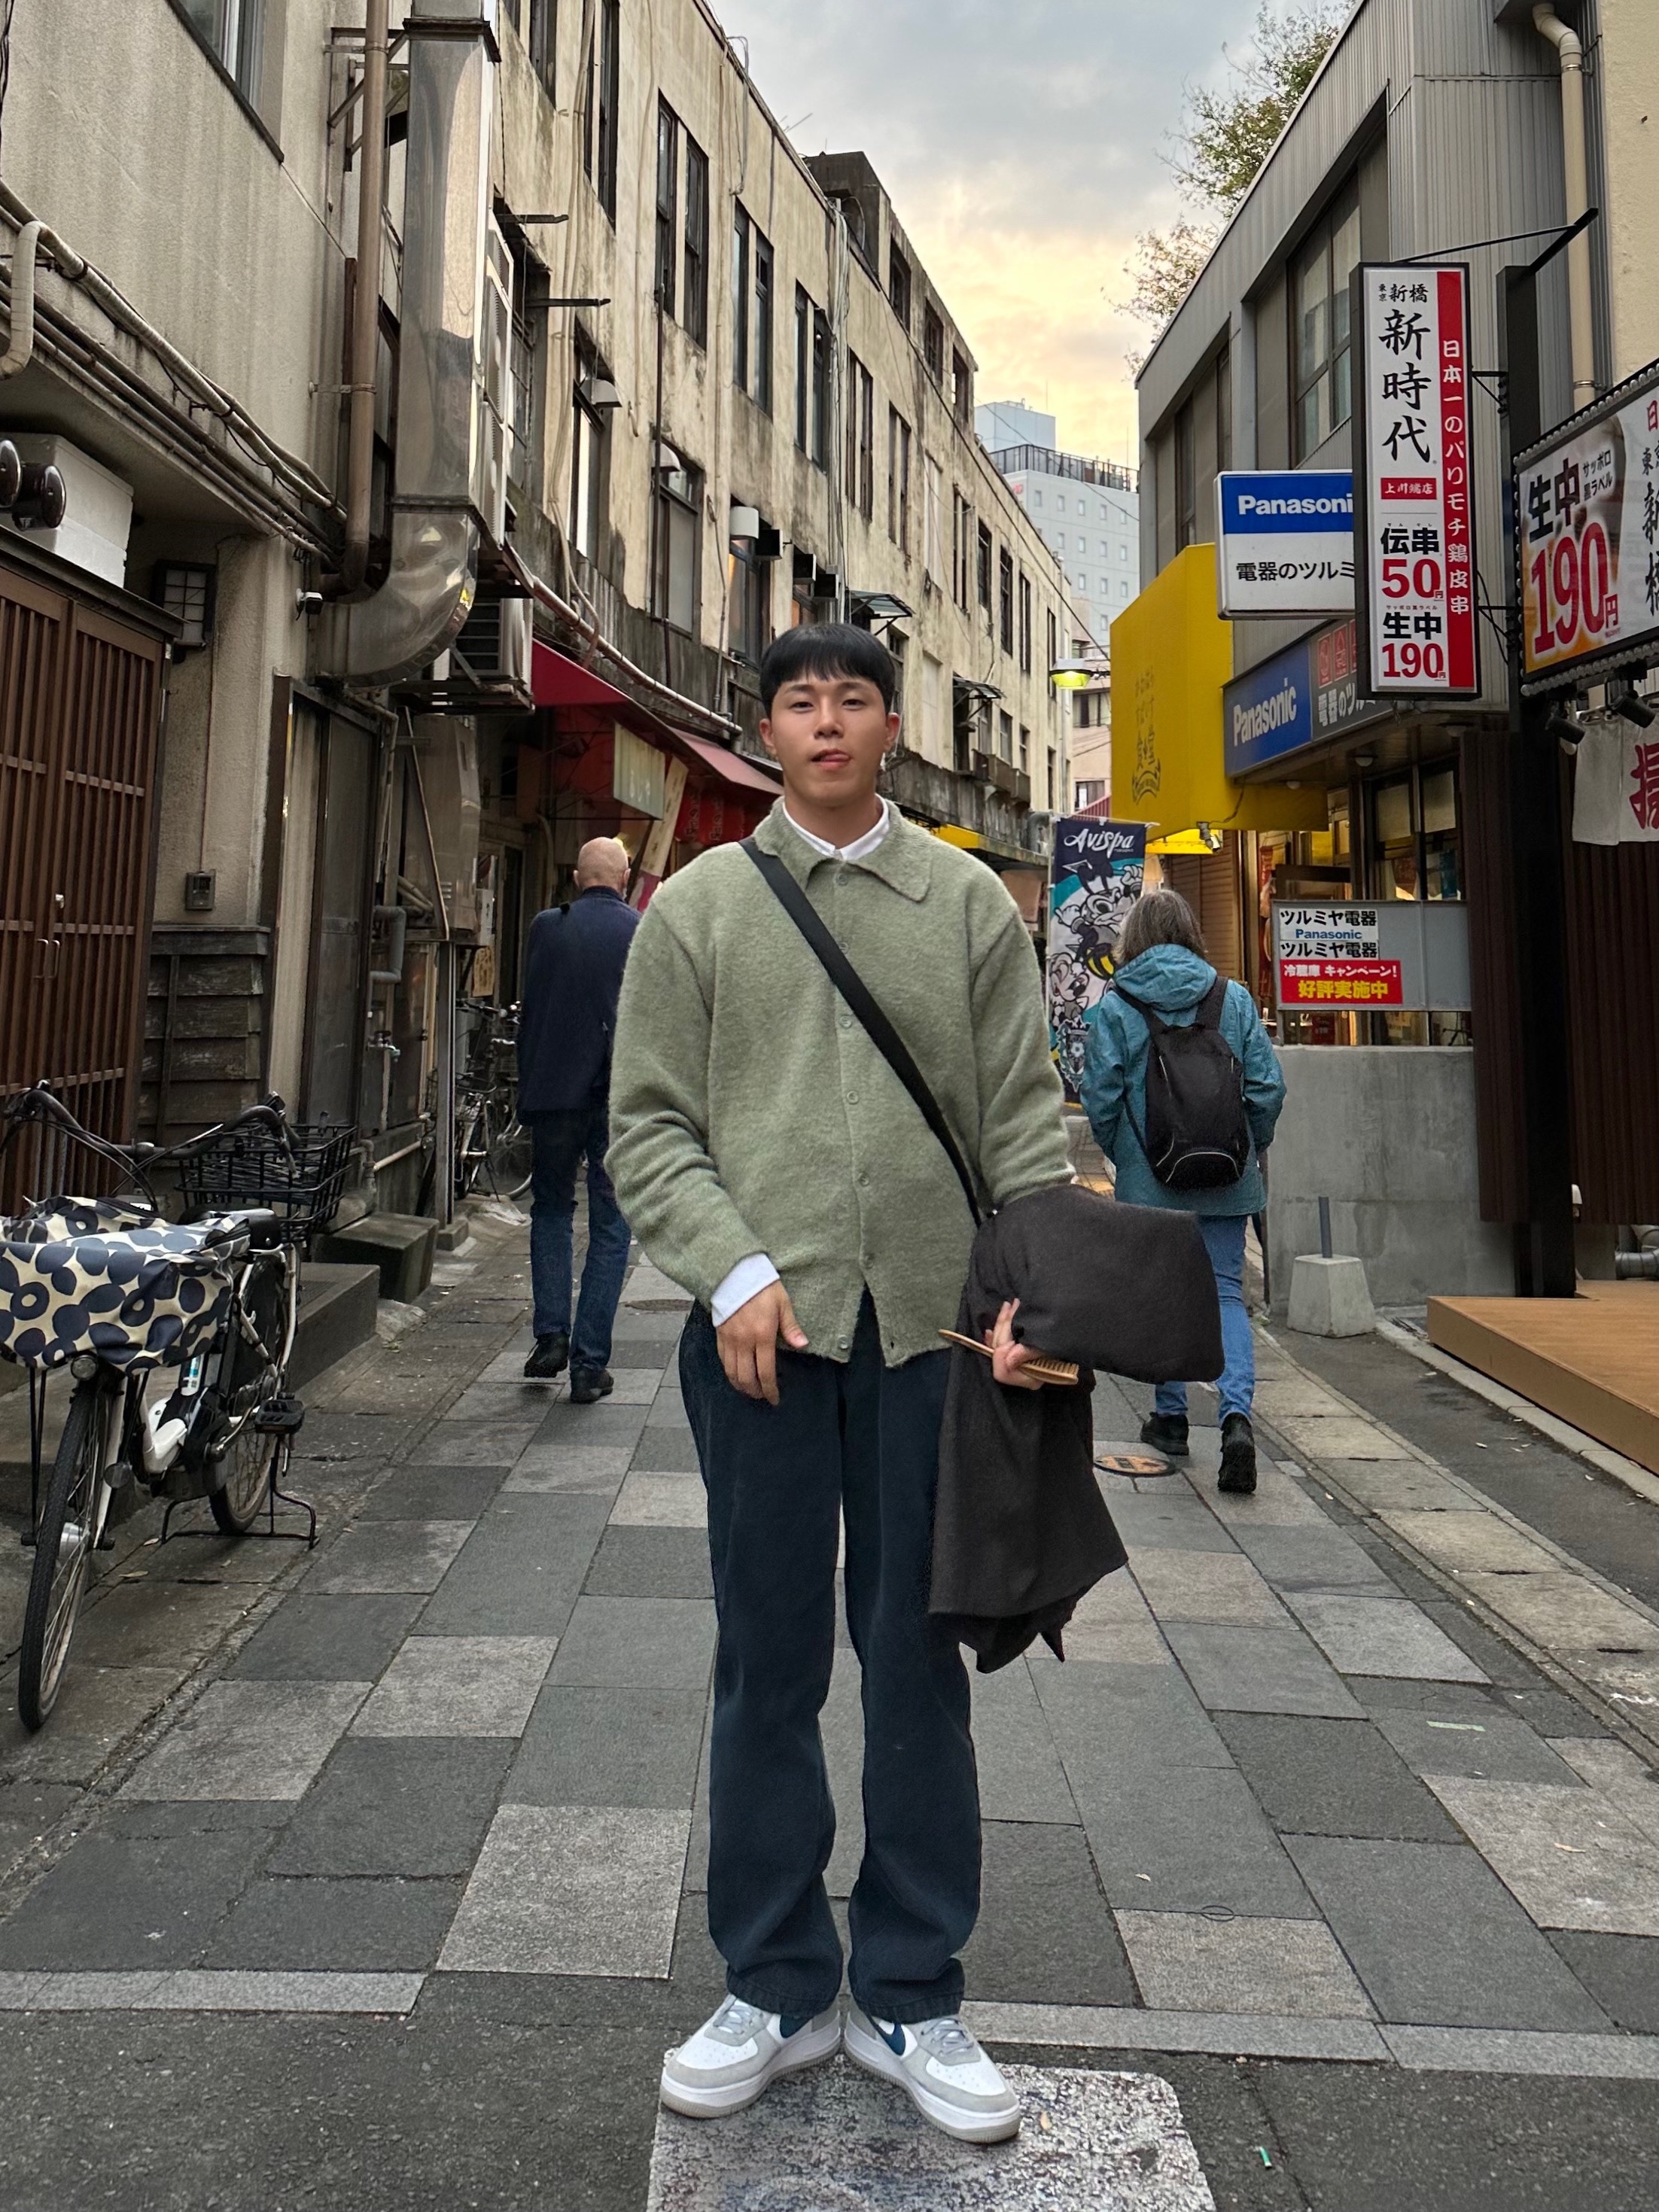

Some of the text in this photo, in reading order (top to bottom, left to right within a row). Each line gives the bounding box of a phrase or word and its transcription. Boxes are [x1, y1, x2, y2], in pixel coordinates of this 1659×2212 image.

[1378, 283, 1429, 303] 東京 新橋
[1378, 309, 1432, 464] 新時代
[1583, 449, 1611, 478] サッポロ
[1384, 482, 1433, 494] 上川端店
[1584, 471, 1613, 501] 黒ラベル
[1238, 493, 1353, 515] Panasoni
[1529, 458, 1580, 543] 生中
[1380, 527, 1439, 555] 伝串
[1237, 561, 1355, 582] 電器のツルミ
[1383, 612, 1441, 640] 生中
[1234, 677, 1297, 747] Panasonic
[1319, 683, 1376, 727] 電器のツ
[1280, 910, 1377, 926] ツルミヤ電器
[1295, 929, 1362, 939] Panasonic
[1281, 942, 1377, 959] ツルミヤ電器
[1284, 964, 1320, 977] 冷蔵庫
[1298, 980, 1388, 999] 好評実施中
